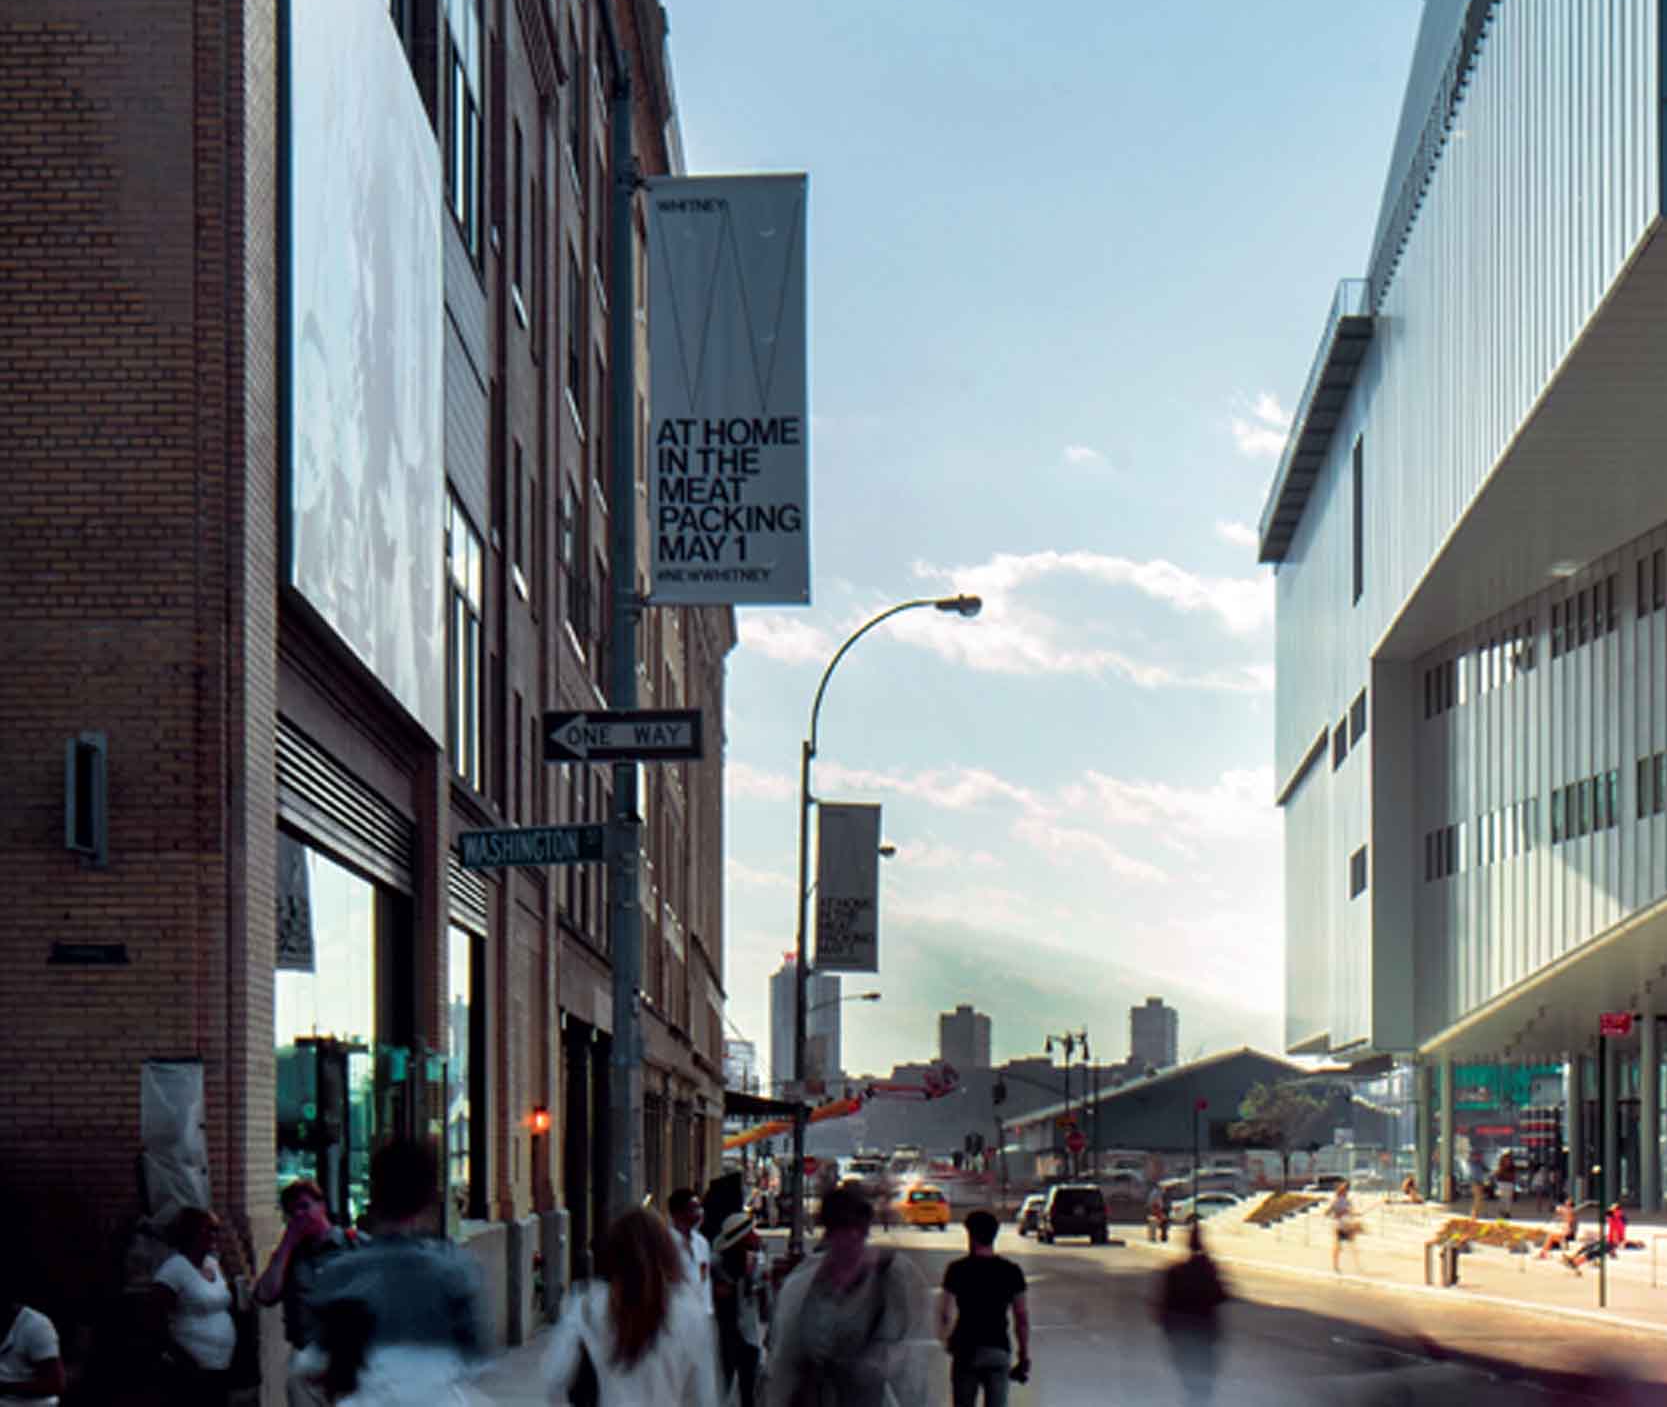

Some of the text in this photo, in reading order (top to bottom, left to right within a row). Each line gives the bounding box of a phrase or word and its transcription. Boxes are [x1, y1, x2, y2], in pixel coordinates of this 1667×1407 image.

[656, 417, 800, 445] AT HOME
[658, 448, 760, 474] IN THE
[658, 477, 747, 504] MEAT
[658, 504, 801, 532] PACKING
[658, 535, 747, 562] MAY 1
[567, 724, 681, 744] ONE WAY
[463, 830, 579, 865] WASHINGTON
